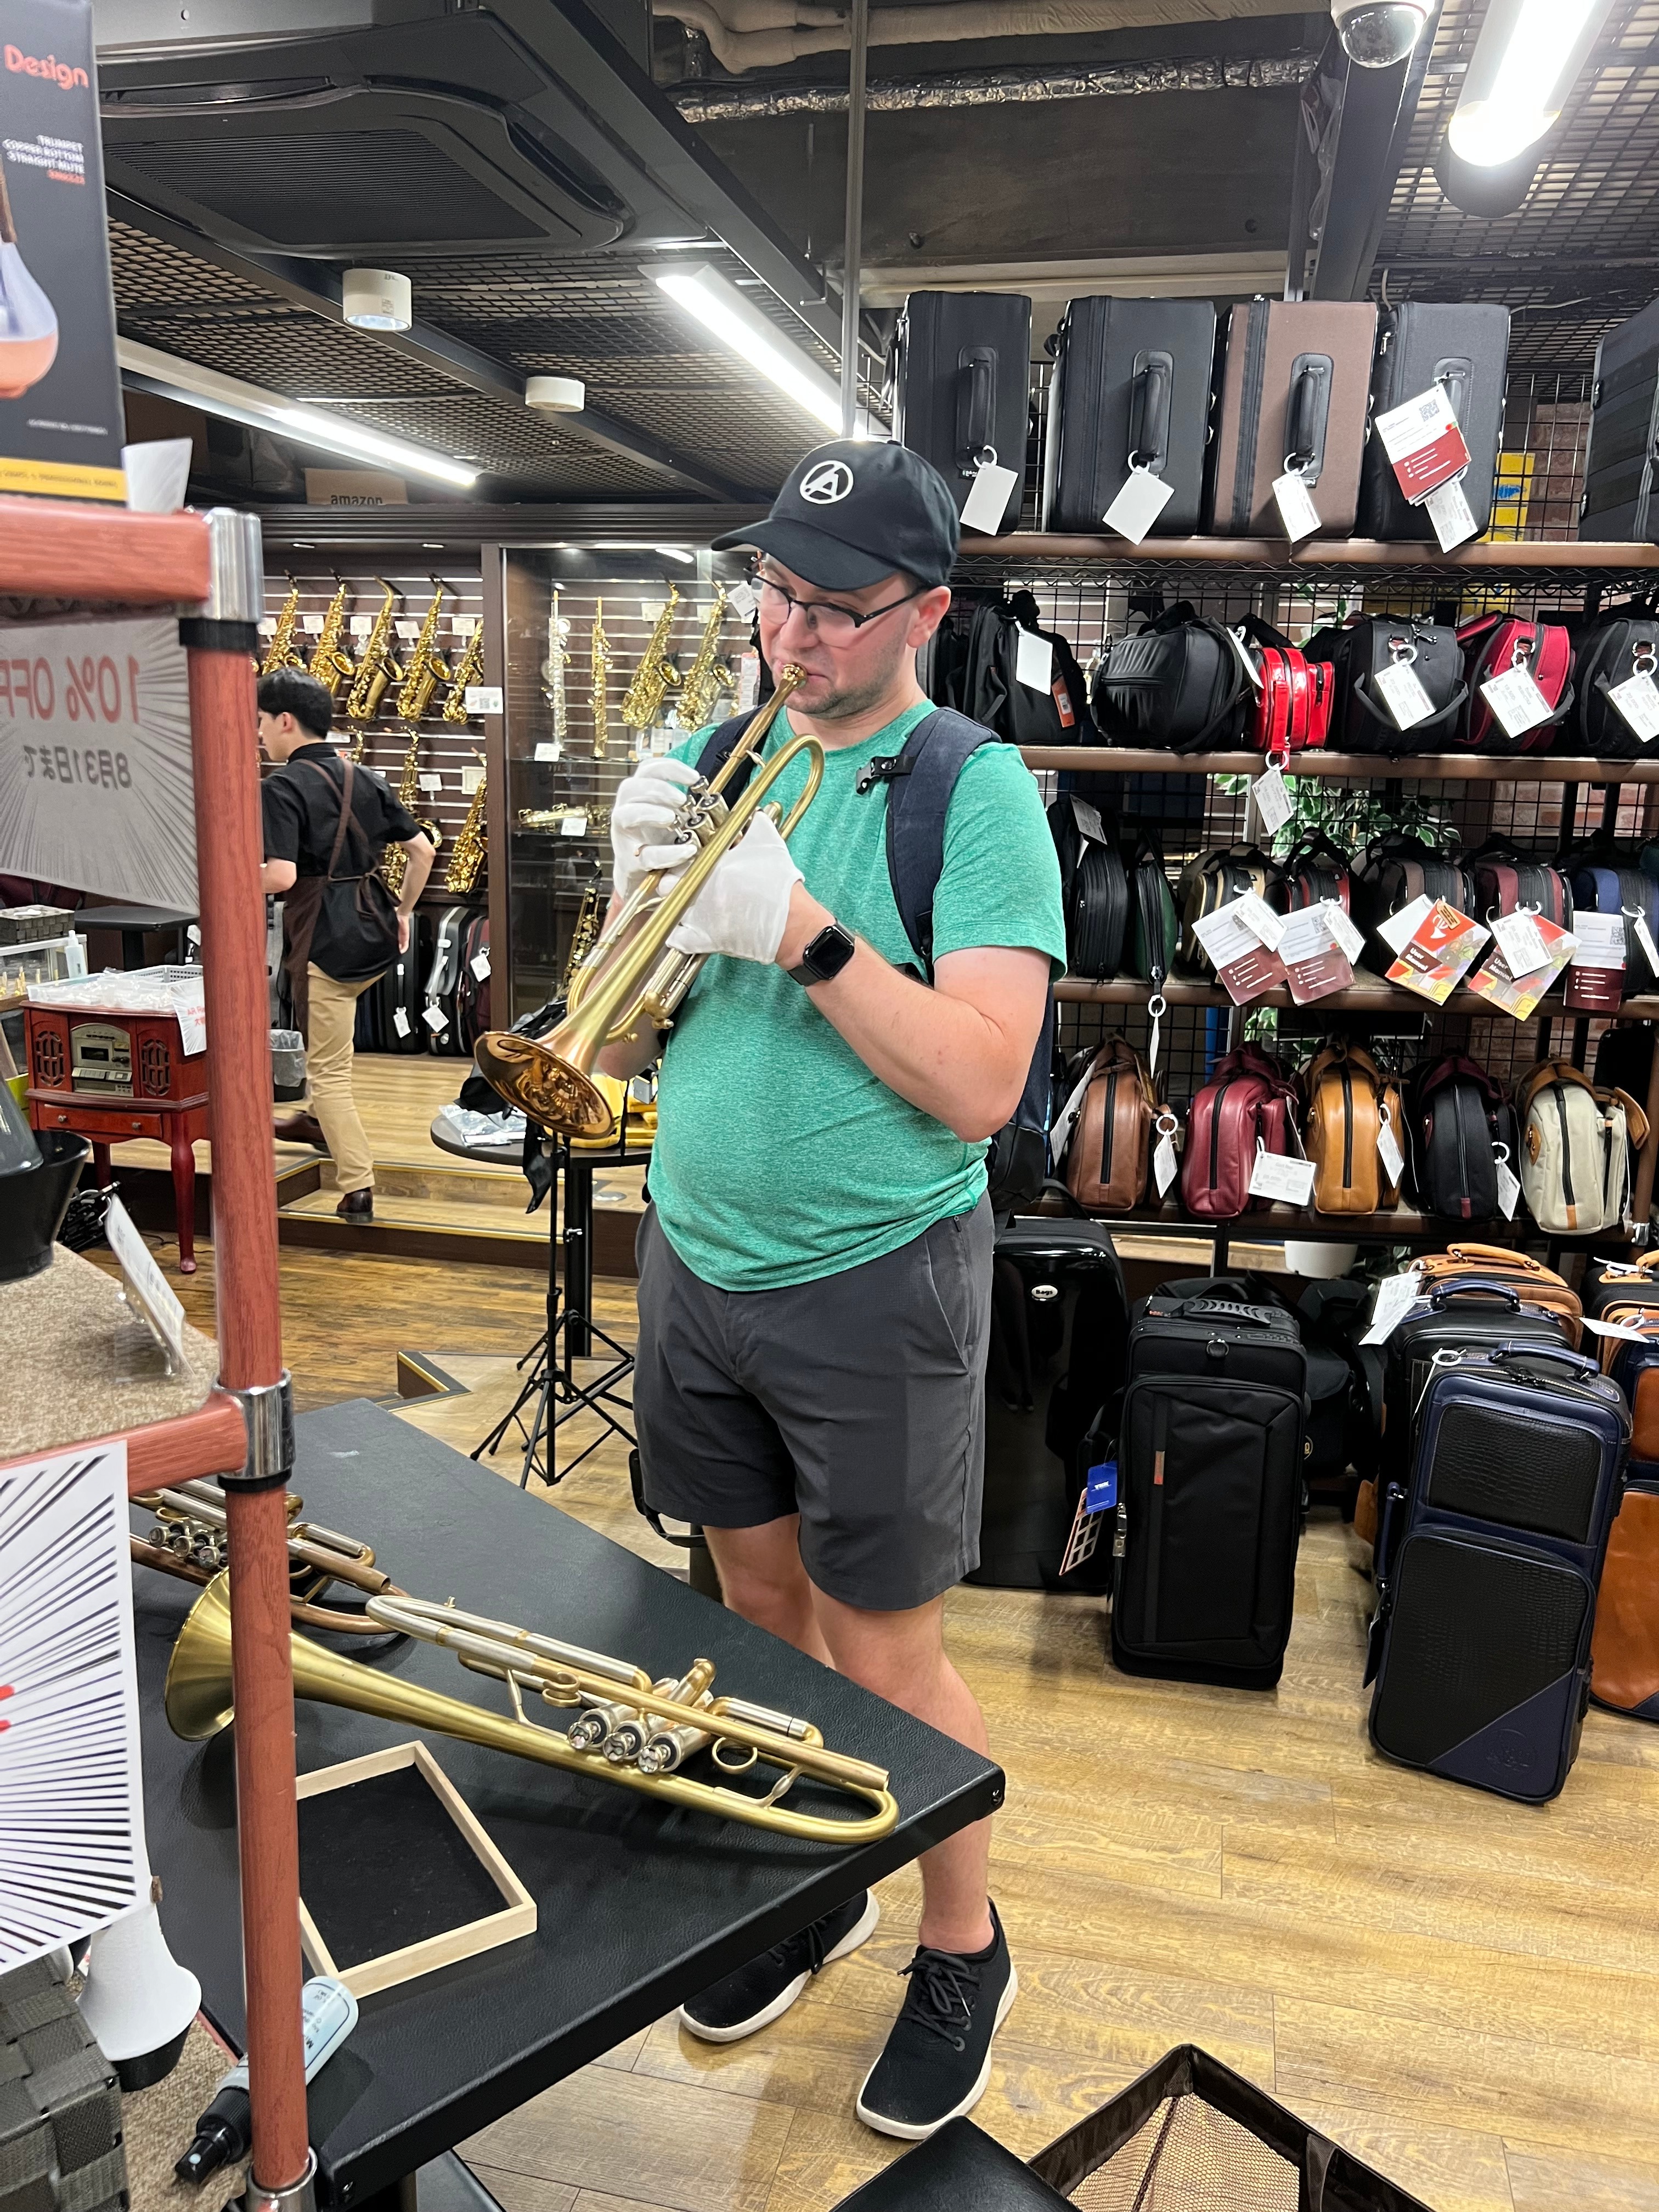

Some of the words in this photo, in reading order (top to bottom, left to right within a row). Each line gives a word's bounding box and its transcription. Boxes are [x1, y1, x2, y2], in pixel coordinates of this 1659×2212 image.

[3, 43, 89, 90] Design
[331, 494, 383, 506] amazon
[1409, 947, 1425, 960] User
[1404, 953, 1429, 972] Manual
[1493, 957, 1509, 970] User
[1488, 963, 1514, 981] Manual
